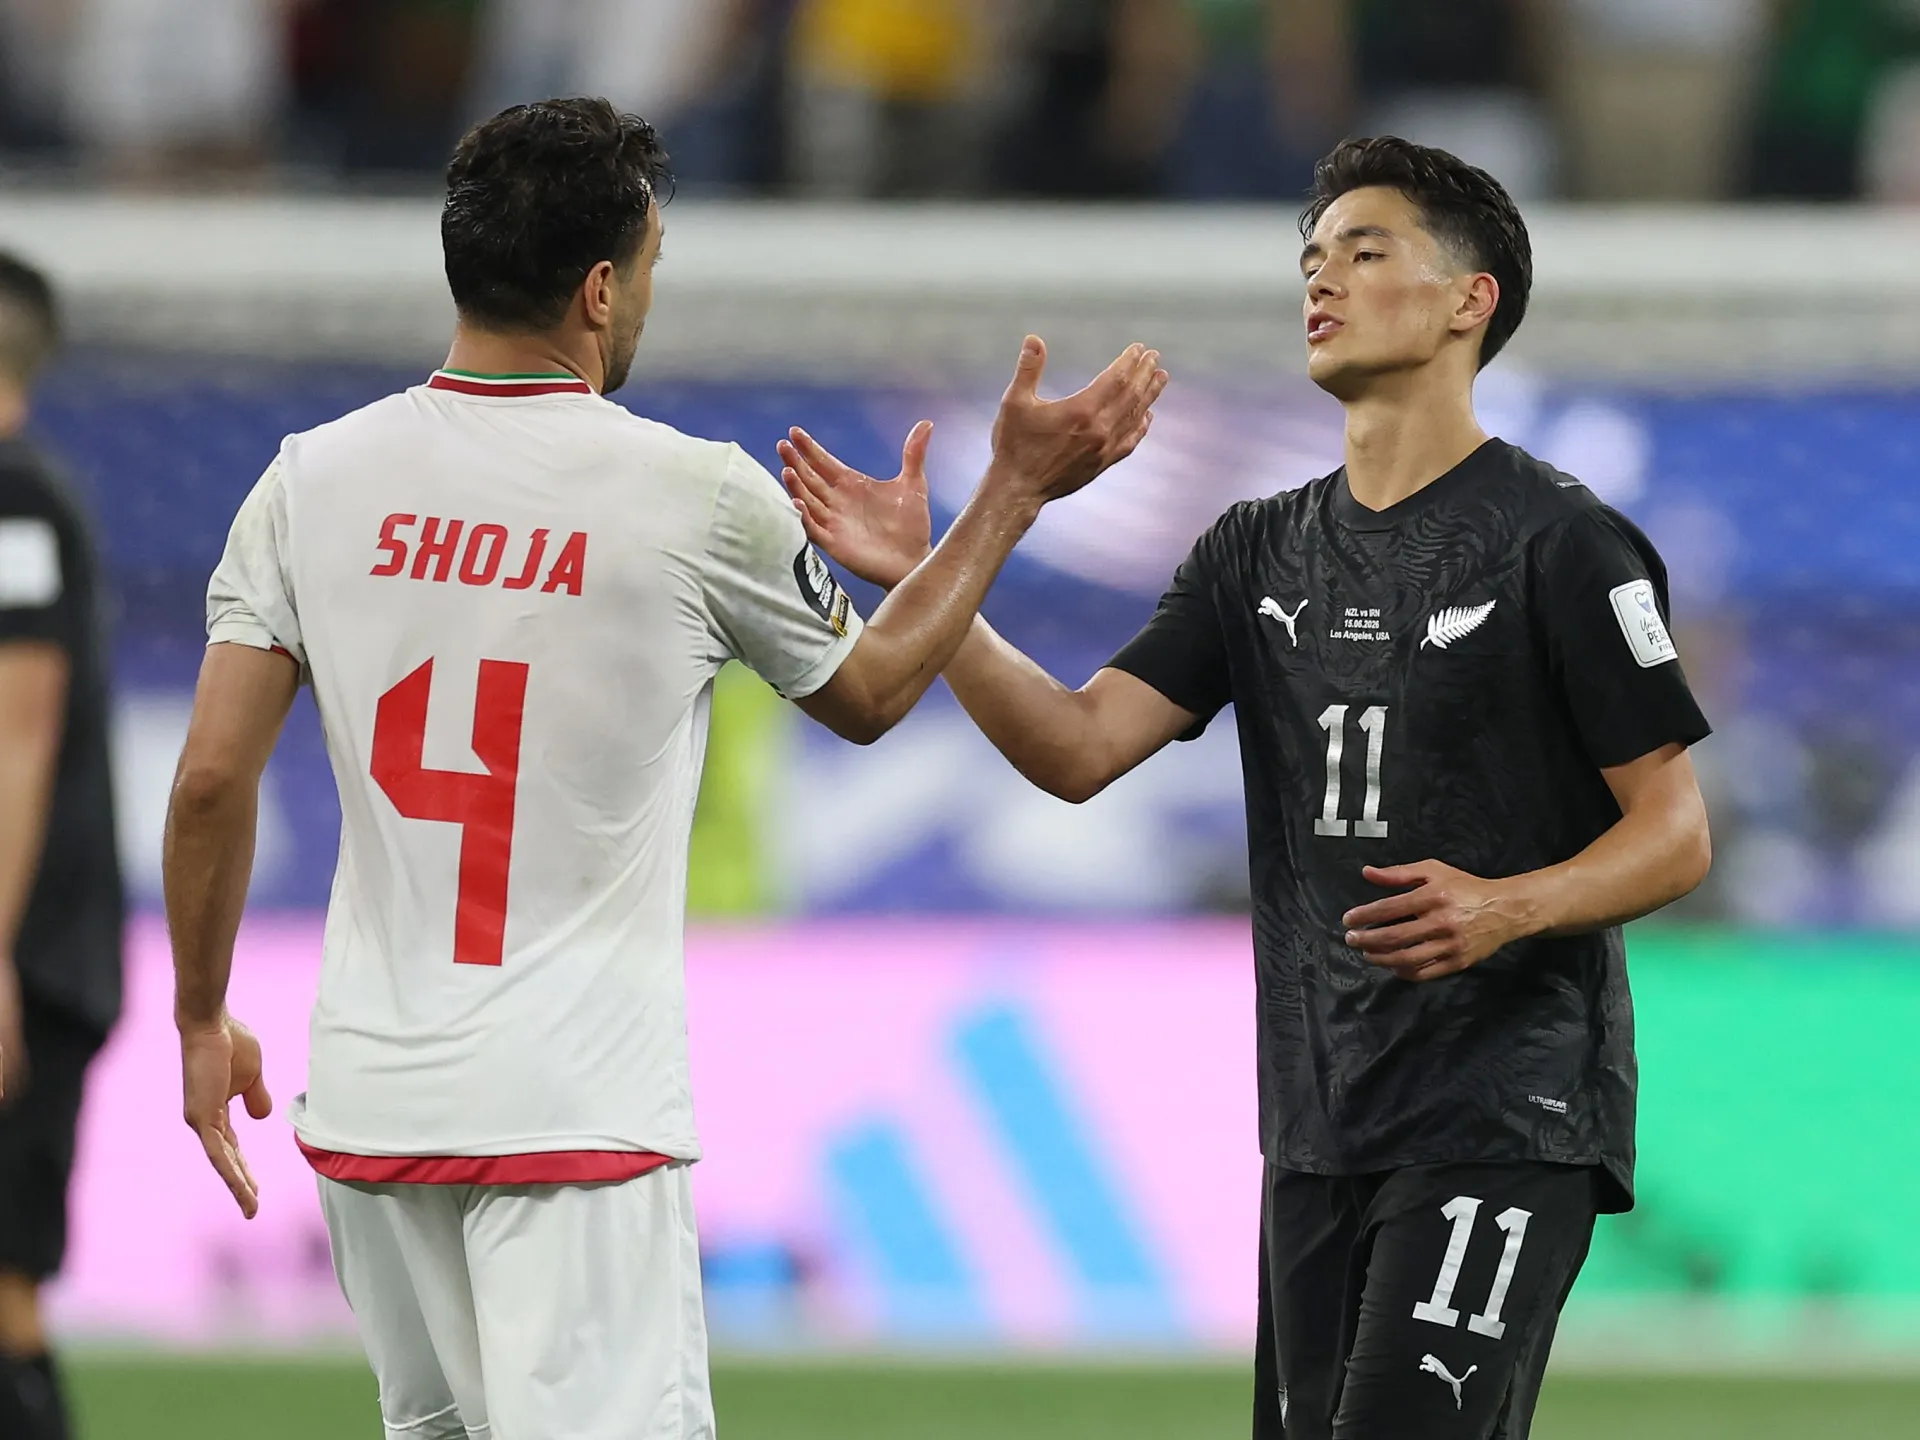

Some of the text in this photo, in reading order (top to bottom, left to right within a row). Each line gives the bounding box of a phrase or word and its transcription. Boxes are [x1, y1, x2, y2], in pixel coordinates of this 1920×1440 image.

[369, 513, 587, 597] SHOJA
[1330, 629, 1390, 641] Los Angeles, USA
[1344, 608, 1381, 617] NZL vs IRN
[1344, 619, 1380, 629] 15.06.2026
[369, 656, 530, 967] 4
[1314, 704, 1389, 838] 11
[1412, 1195, 1534, 1341] 11
